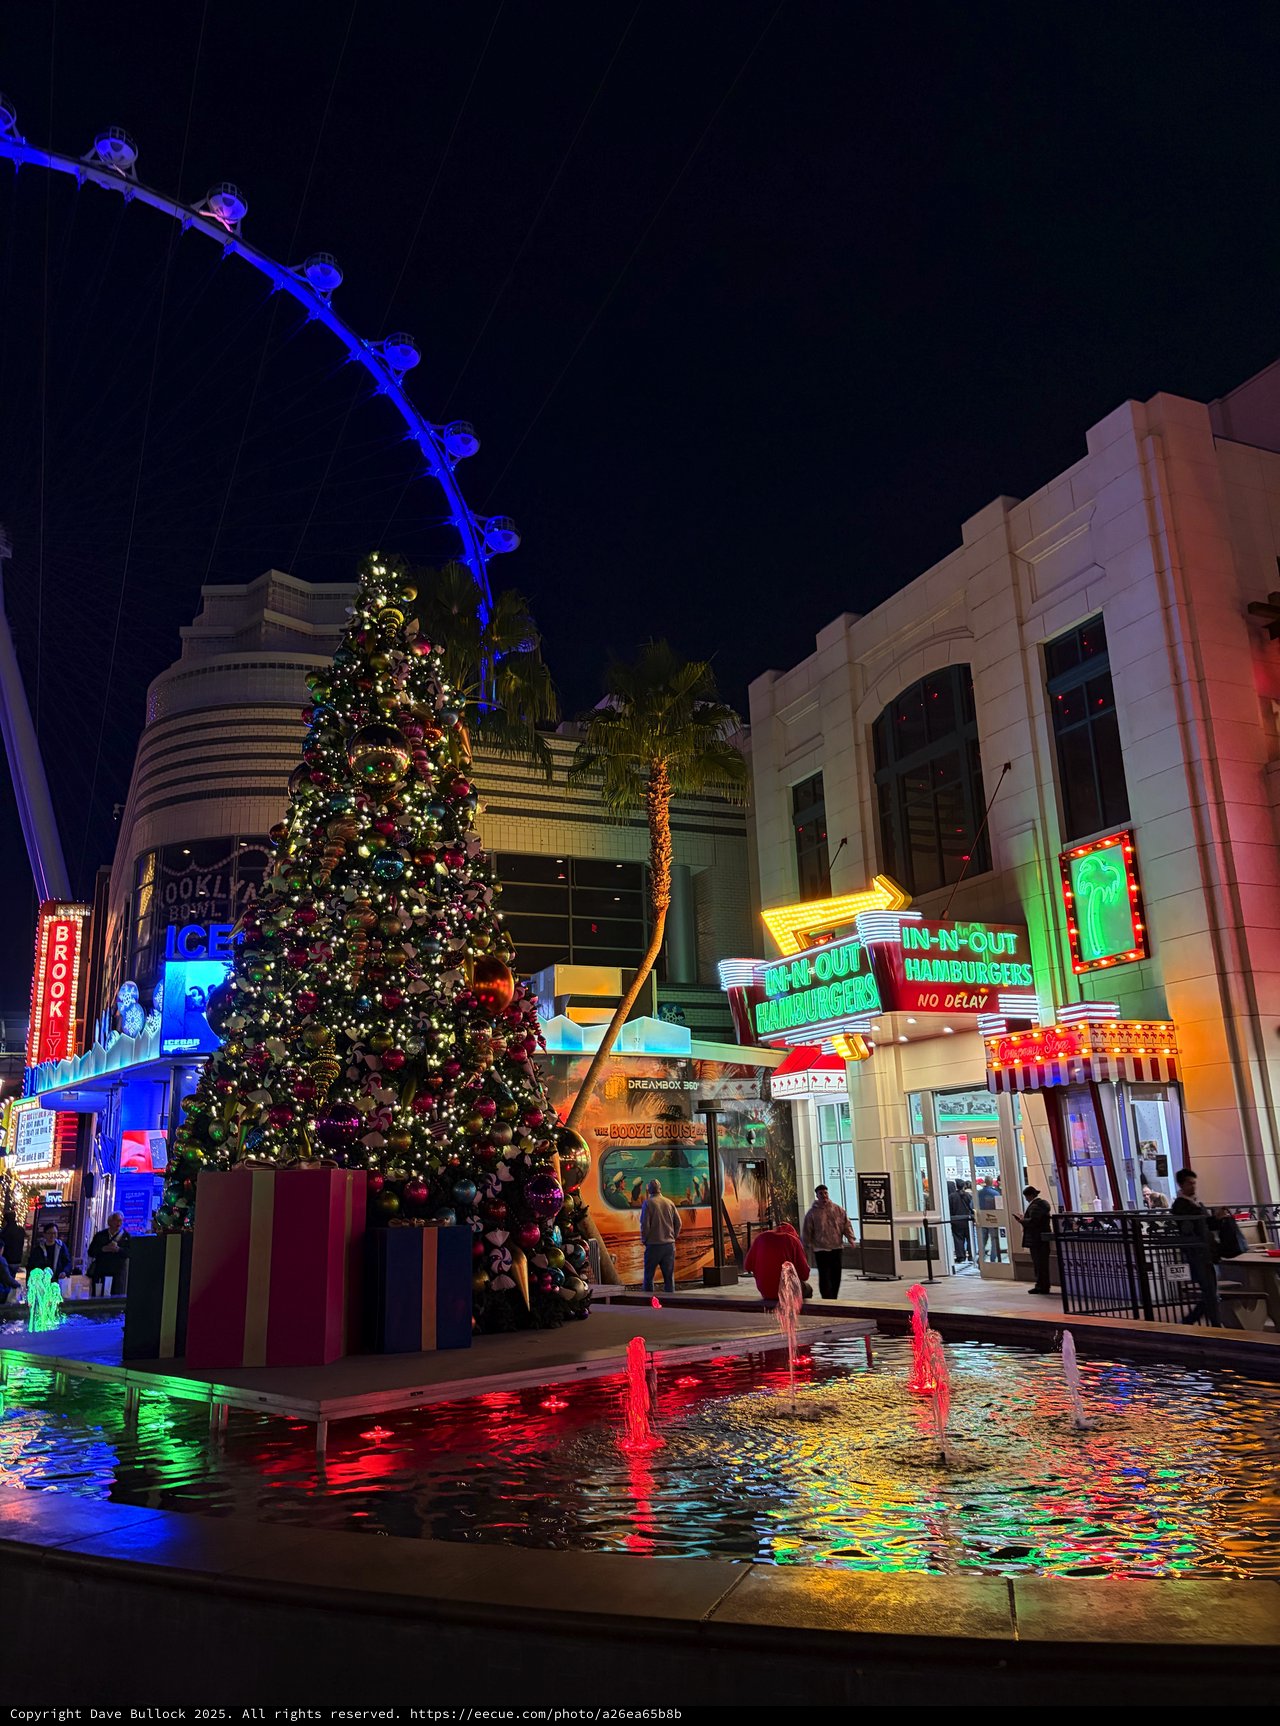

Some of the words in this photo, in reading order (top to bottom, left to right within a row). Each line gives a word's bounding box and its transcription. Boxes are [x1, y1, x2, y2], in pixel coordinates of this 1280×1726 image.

[157, 873, 267, 904] OOKLYN
[170, 900, 222, 921] BOWL
[165, 924, 246, 959] ICE
[902, 926, 1019, 955] IN-N-OUT
[764, 942, 861, 997] IN-N-OUT
[905, 957, 1033, 986] HAMBURGERS
[46, 925, 70, 1066] BROOKLY
[755, 972, 881, 1034] HAMBURGERS
[918, 993, 939, 1008] NO
[944, 994, 988, 1009] DELAY
[628, 1080, 682, 1090] DREAMBOX
[594, 1127, 609, 1137] THE
[610, 1122, 653, 1140] BOOZE
[1170, 1266, 1185, 1274] EXIT
